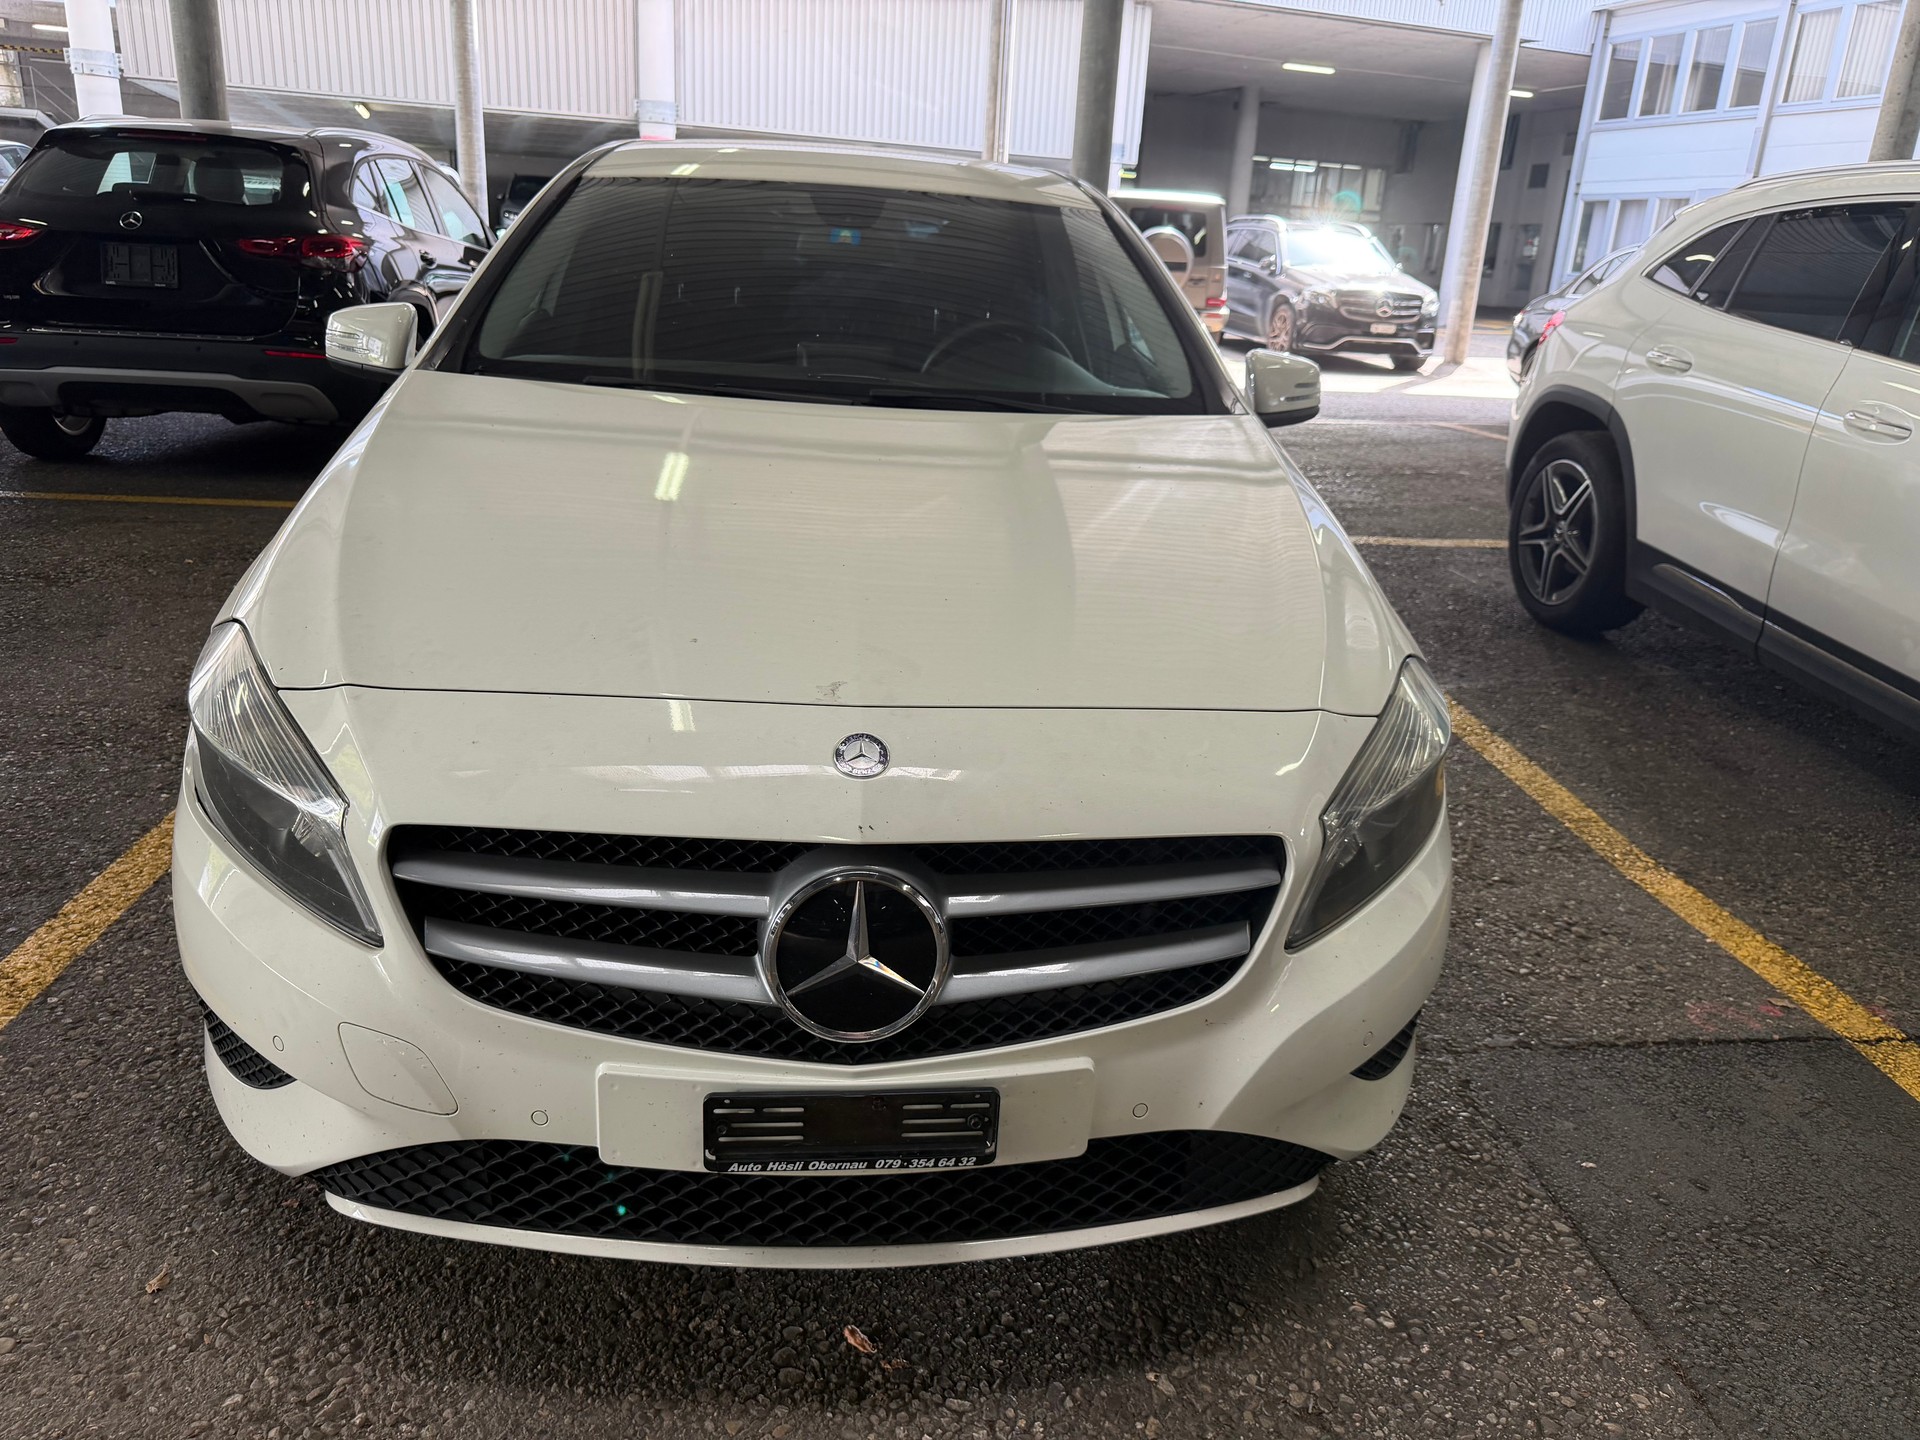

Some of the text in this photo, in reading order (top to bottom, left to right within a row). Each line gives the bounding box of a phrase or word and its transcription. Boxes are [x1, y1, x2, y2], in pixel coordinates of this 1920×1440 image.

[728, 1162, 762, 1172] Auto
[766, 1161, 804, 1171] Hösli
[808, 1160, 868, 1170] Obernau
[937, 1157, 956, 1167] 64
[958, 1156, 977, 1166] 32
